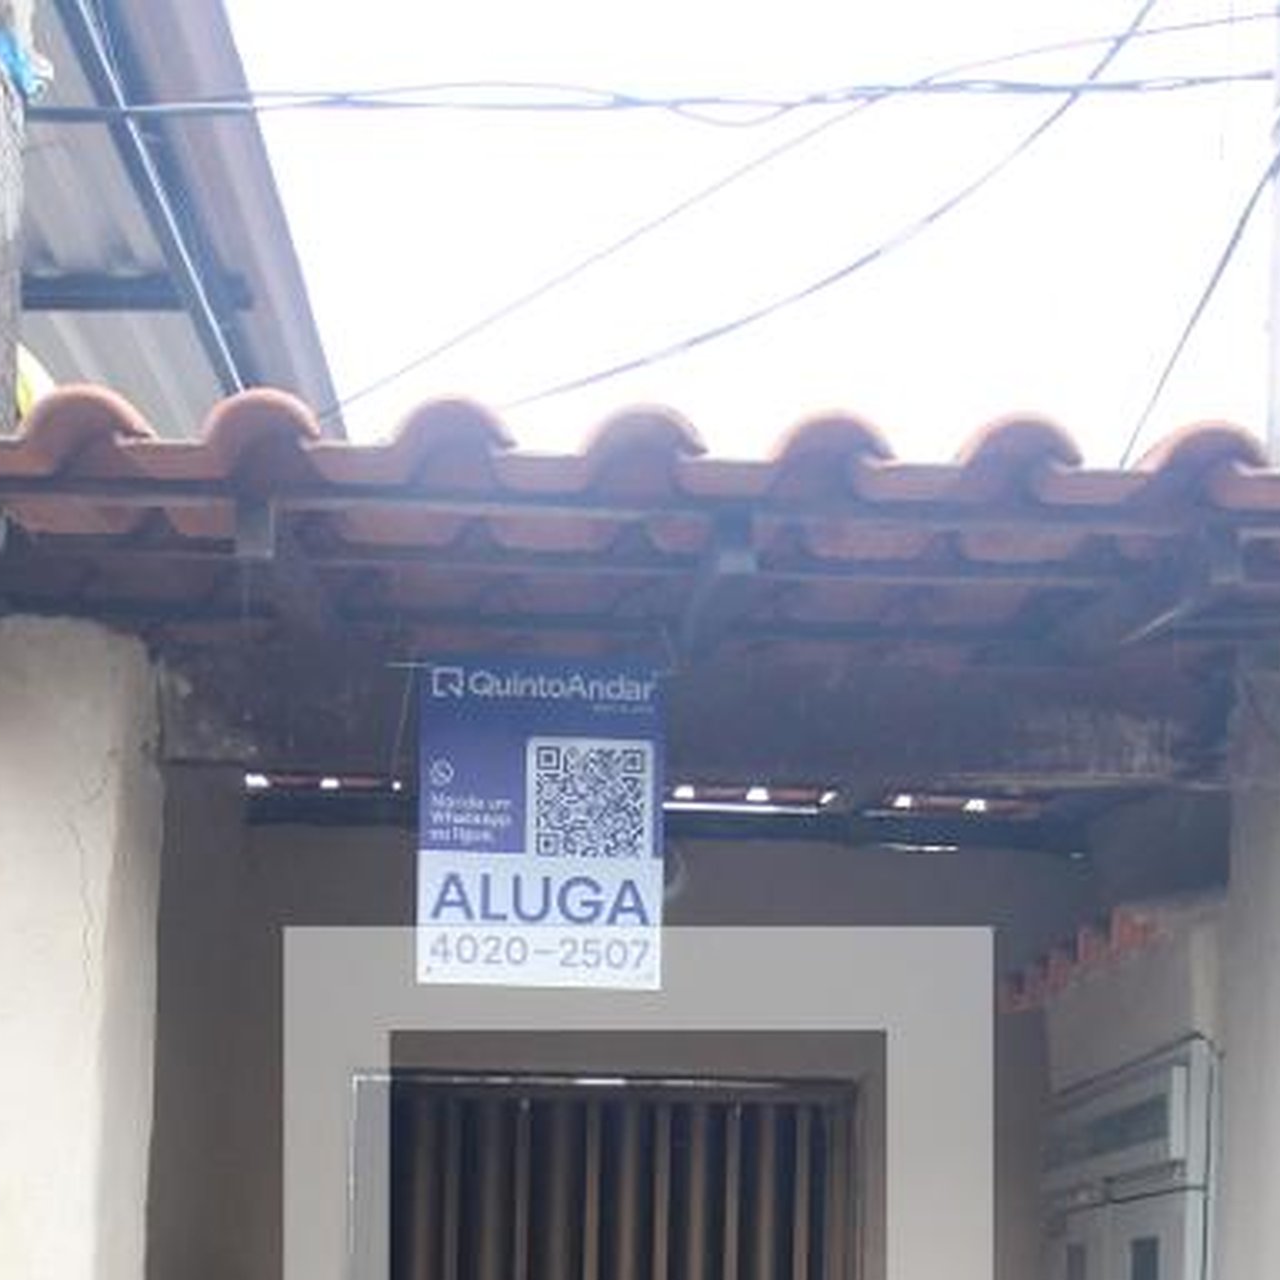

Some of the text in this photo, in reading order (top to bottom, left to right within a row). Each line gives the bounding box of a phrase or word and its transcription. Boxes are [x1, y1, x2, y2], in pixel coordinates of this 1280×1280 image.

[469, 669, 654, 700] QuintoAndar
[430, 872, 651, 926] ALUGA
[429, 933, 651, 969] 4020-2507
